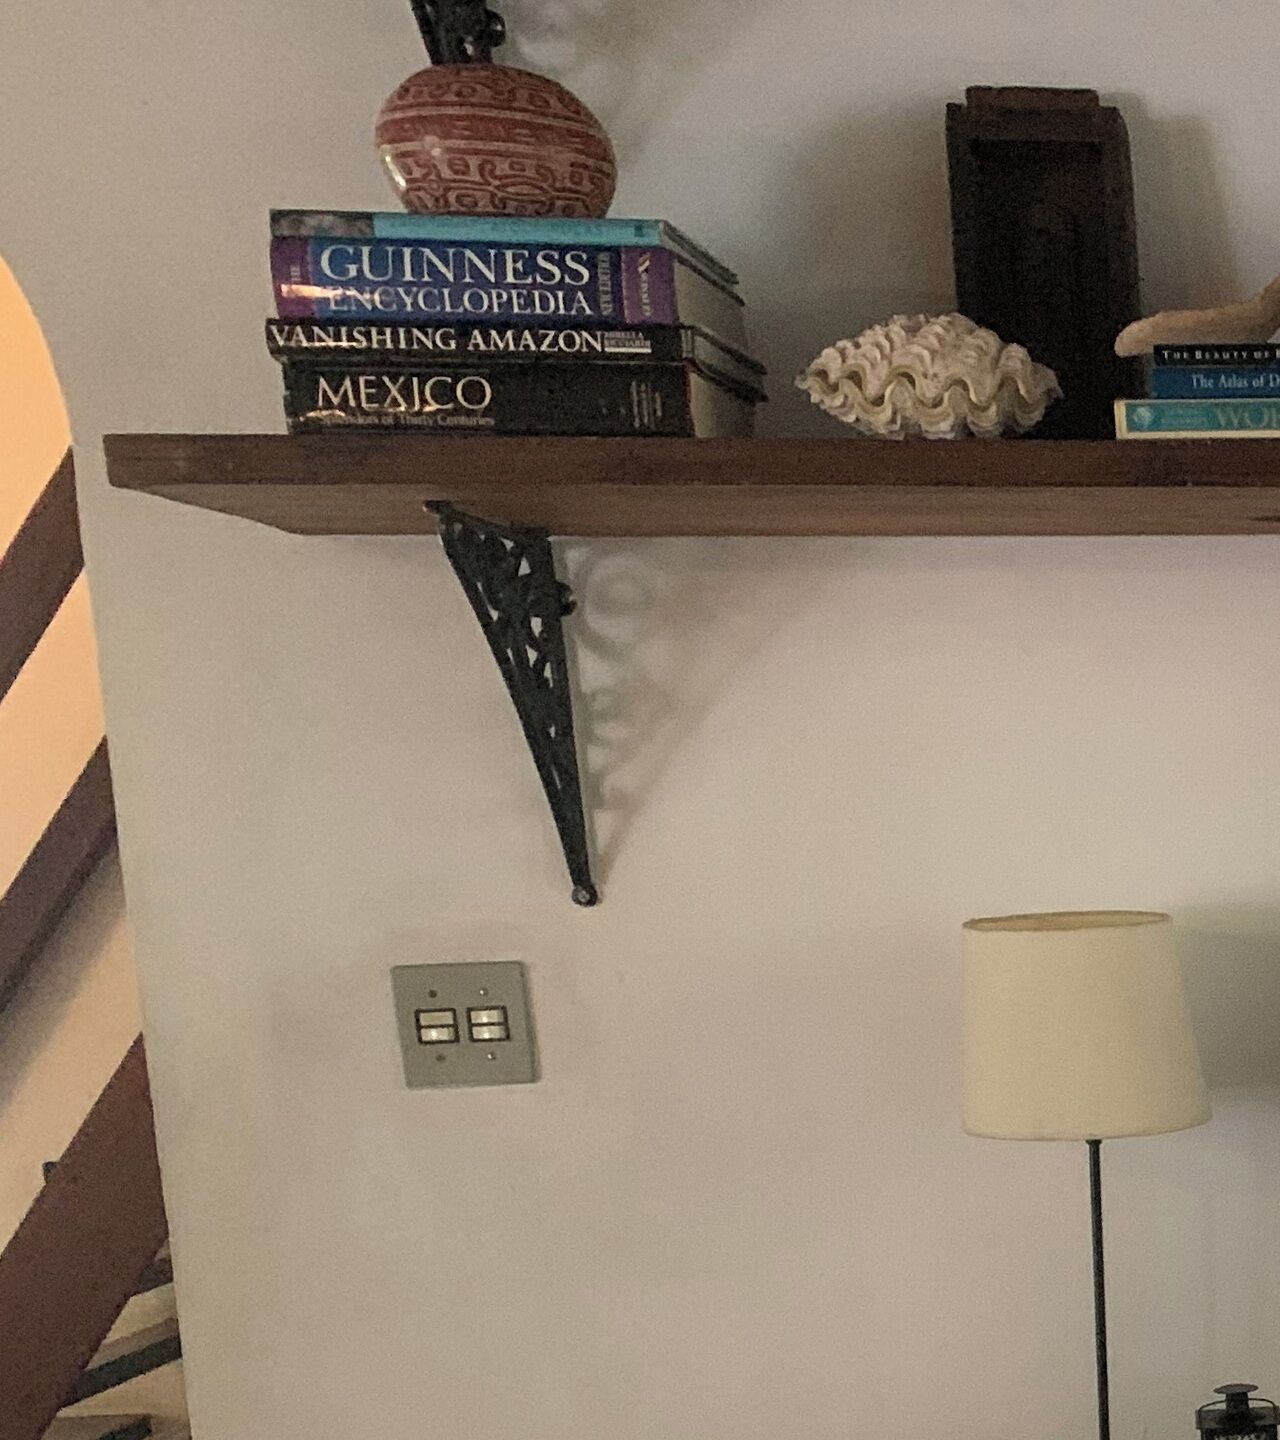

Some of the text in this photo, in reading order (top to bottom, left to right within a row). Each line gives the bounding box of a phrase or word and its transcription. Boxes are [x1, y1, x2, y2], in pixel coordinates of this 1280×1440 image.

[321, 244, 591, 286] GUINNESS
[328, 285, 595, 316] ENCYCLOPEDIA
[269, 325, 602, 353] VANISHING AMAZON
[317, 375, 493, 411] MEXICO
[1191, 374, 1214, 389] The
[1218, 373, 1249, 389] Atlas
[1252, 372, 1265, 389] of
